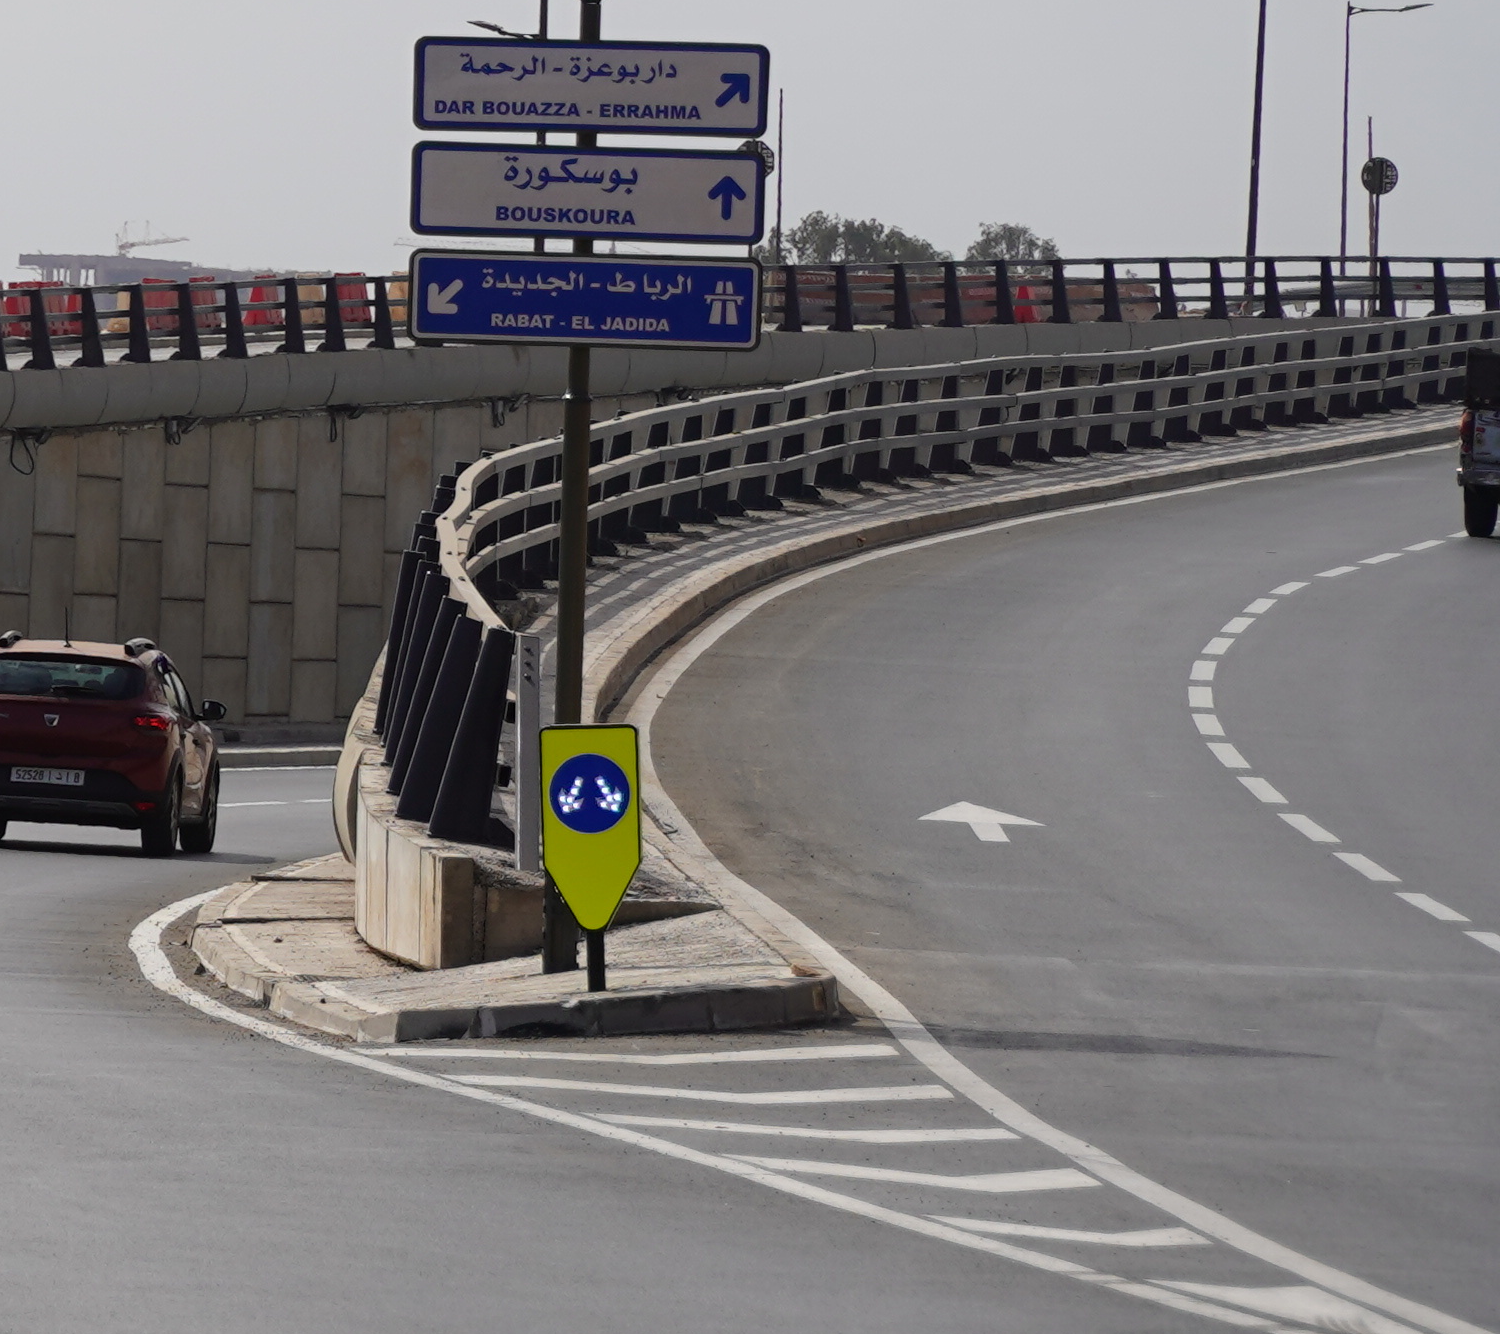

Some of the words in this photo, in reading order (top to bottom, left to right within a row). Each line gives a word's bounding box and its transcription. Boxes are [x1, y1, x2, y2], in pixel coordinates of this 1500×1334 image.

[460, 52, 546, 82] الرحمة
[434, 100, 475, 115] DAR
[482, 101, 580, 117] BOUAZZA
[599, 103, 702, 119] ERRAHMA
[503, 155, 638, 195] بوسكورة
[495, 205, 636, 226] BOUSKOURA
[481, 268, 584, 297] الجديدة
[490, 313, 555, 329] RABAT
[571, 316, 594, 330] EL
[600, 317, 670, 332] JADIDA
